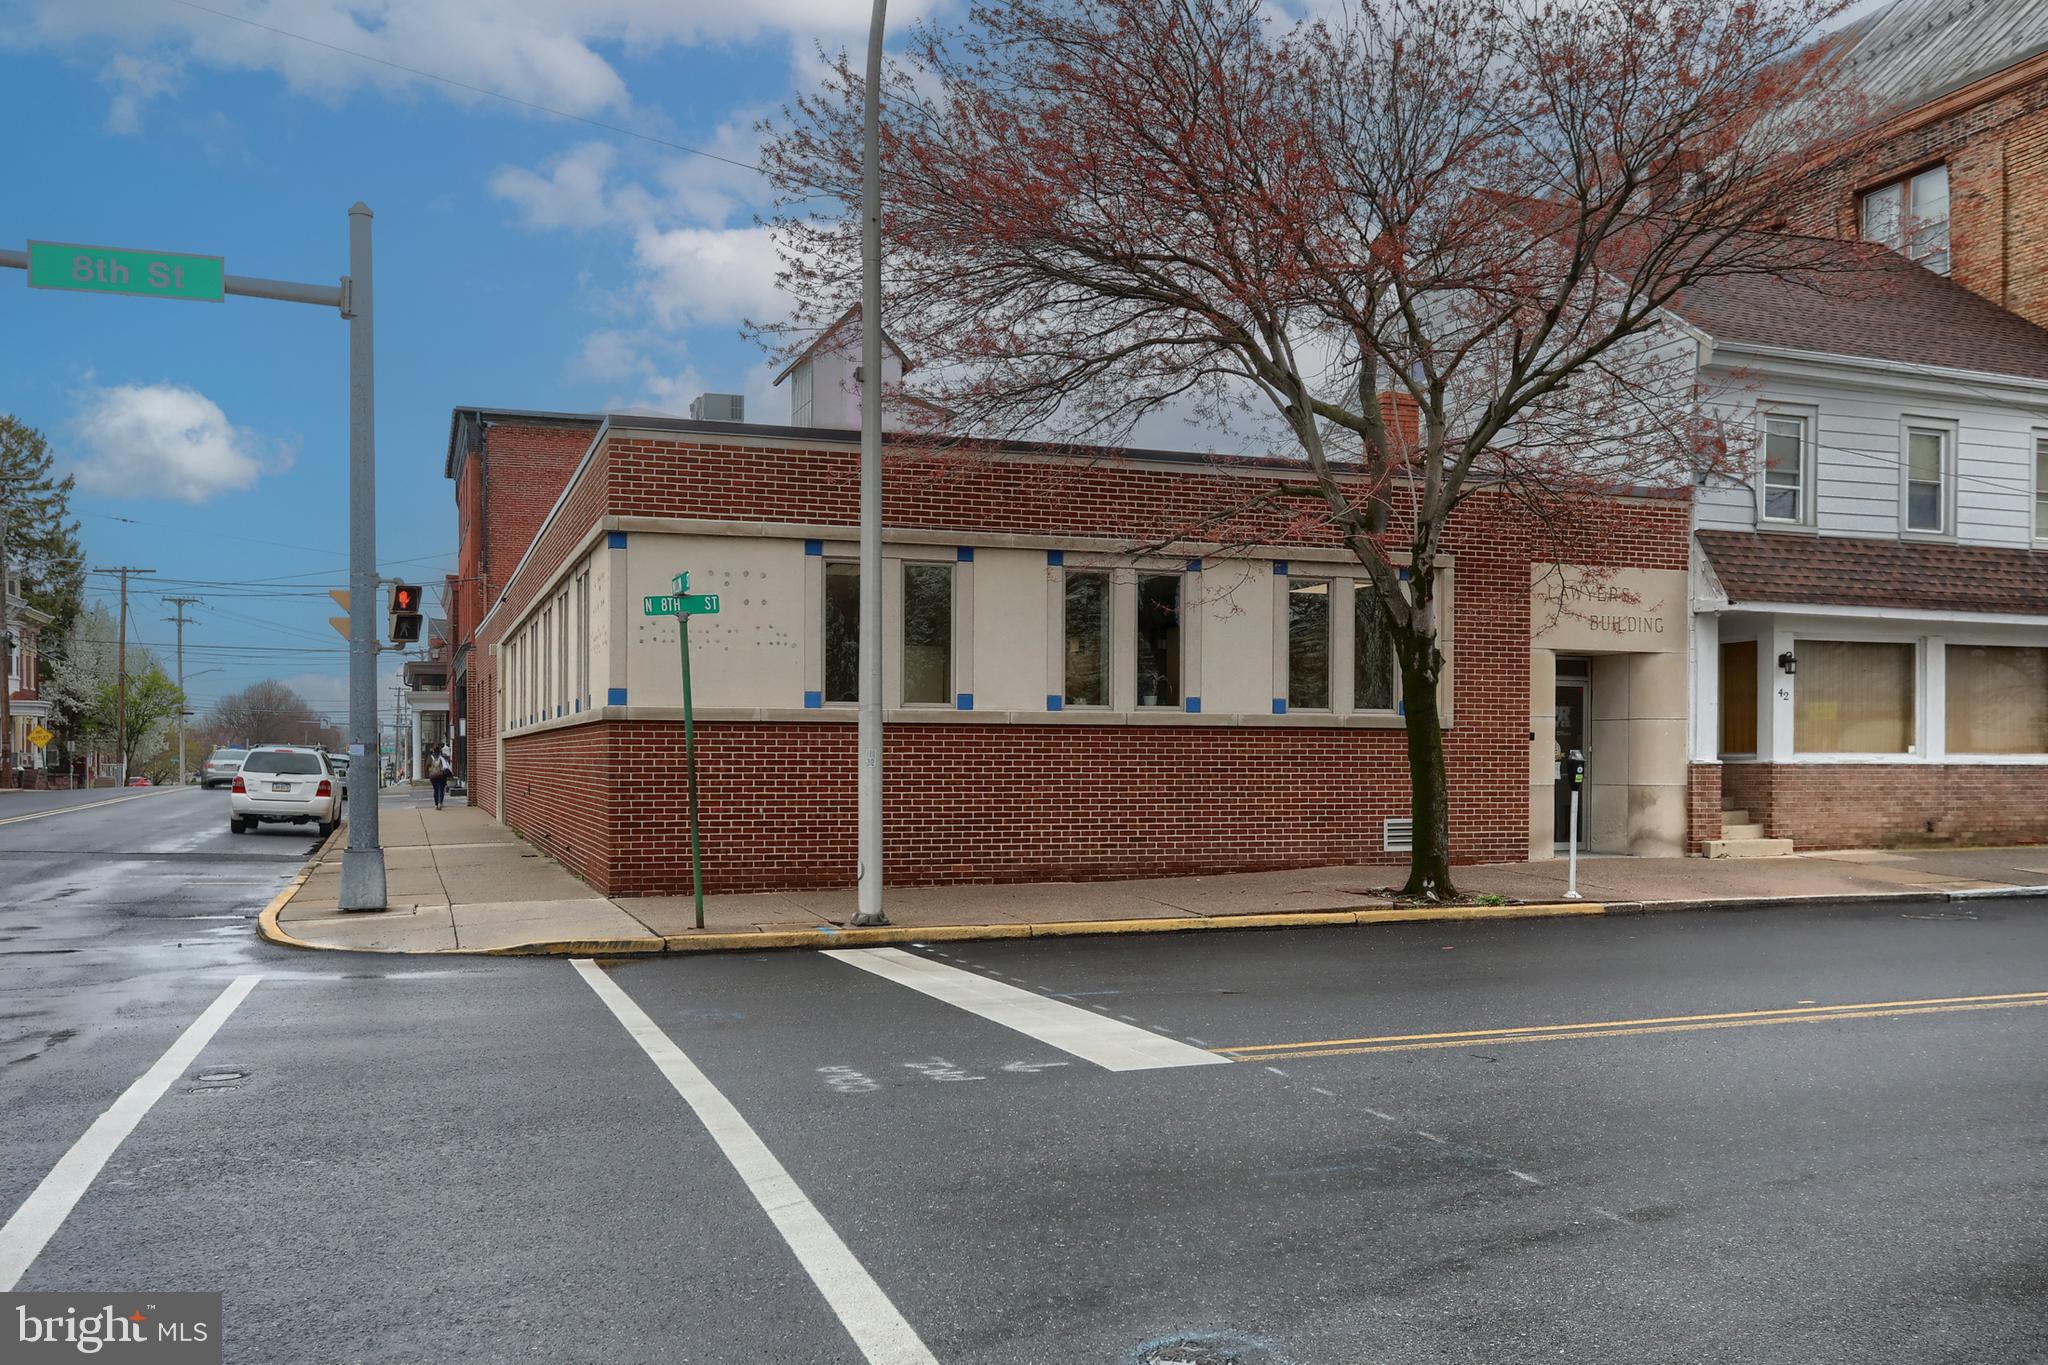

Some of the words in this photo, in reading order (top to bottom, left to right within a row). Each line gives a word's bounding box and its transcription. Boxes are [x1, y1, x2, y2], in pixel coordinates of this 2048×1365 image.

[71, 255, 129, 285] 8th
[147, 261, 185, 289] St
[645, 598, 652, 612] N
[661, 597, 680, 611] 8TH
[704, 596, 717, 610] ST
[1590, 615, 1664, 634] BUILDING
[1777, 687, 1789, 700] 42
